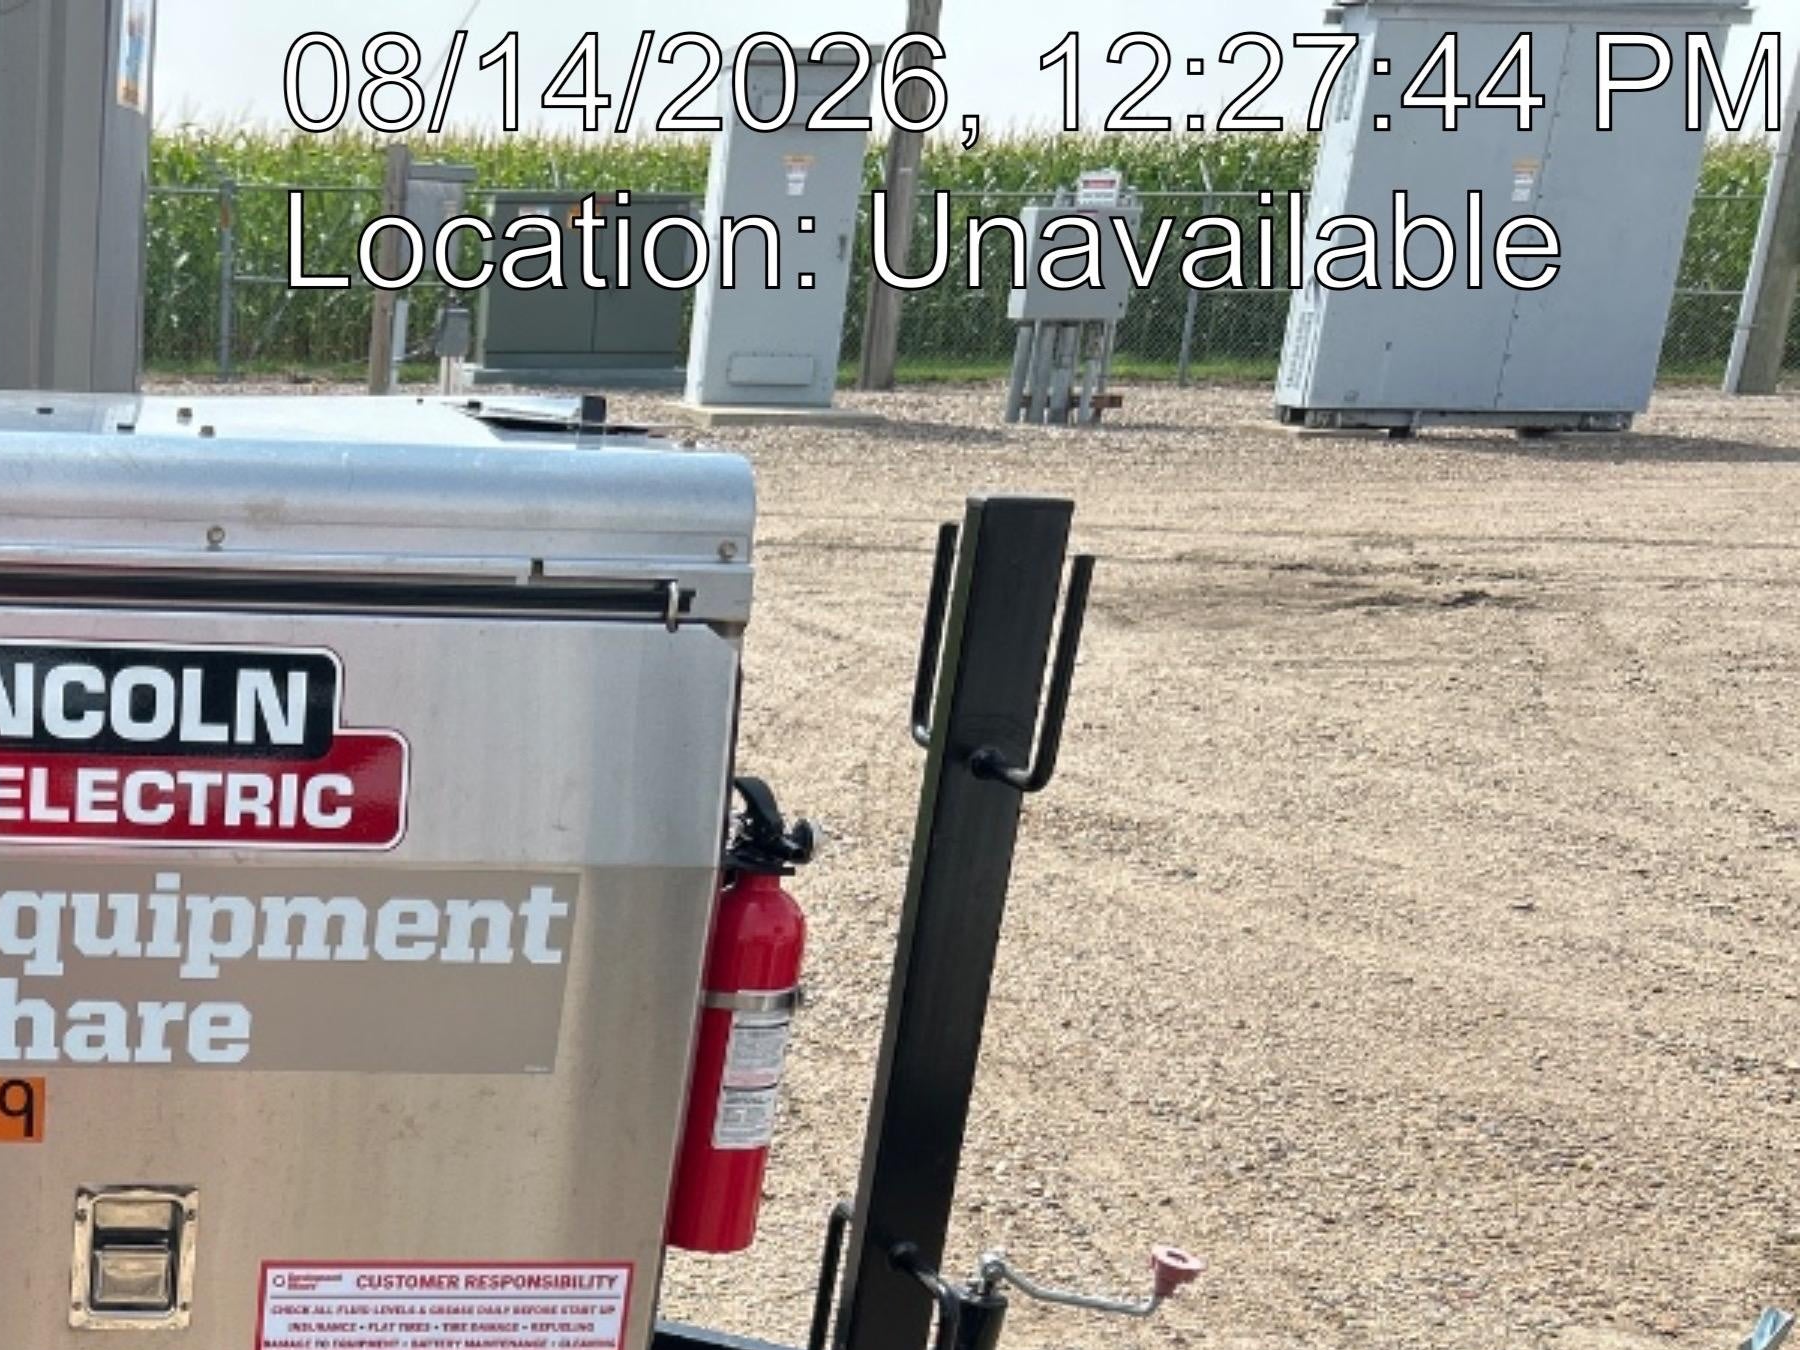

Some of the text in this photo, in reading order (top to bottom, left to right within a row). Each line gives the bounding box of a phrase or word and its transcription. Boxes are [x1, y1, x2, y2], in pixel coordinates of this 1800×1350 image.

[356, 1274, 460, 1291] CUSTOMER
[464, 1273, 619, 1291] RESPONSIBILITY
[270, 1304, 309, 1316] CHECK
[287, 1322, 357, 1333] INSURANCE
[368, 1322, 396, 1333] FLAT
